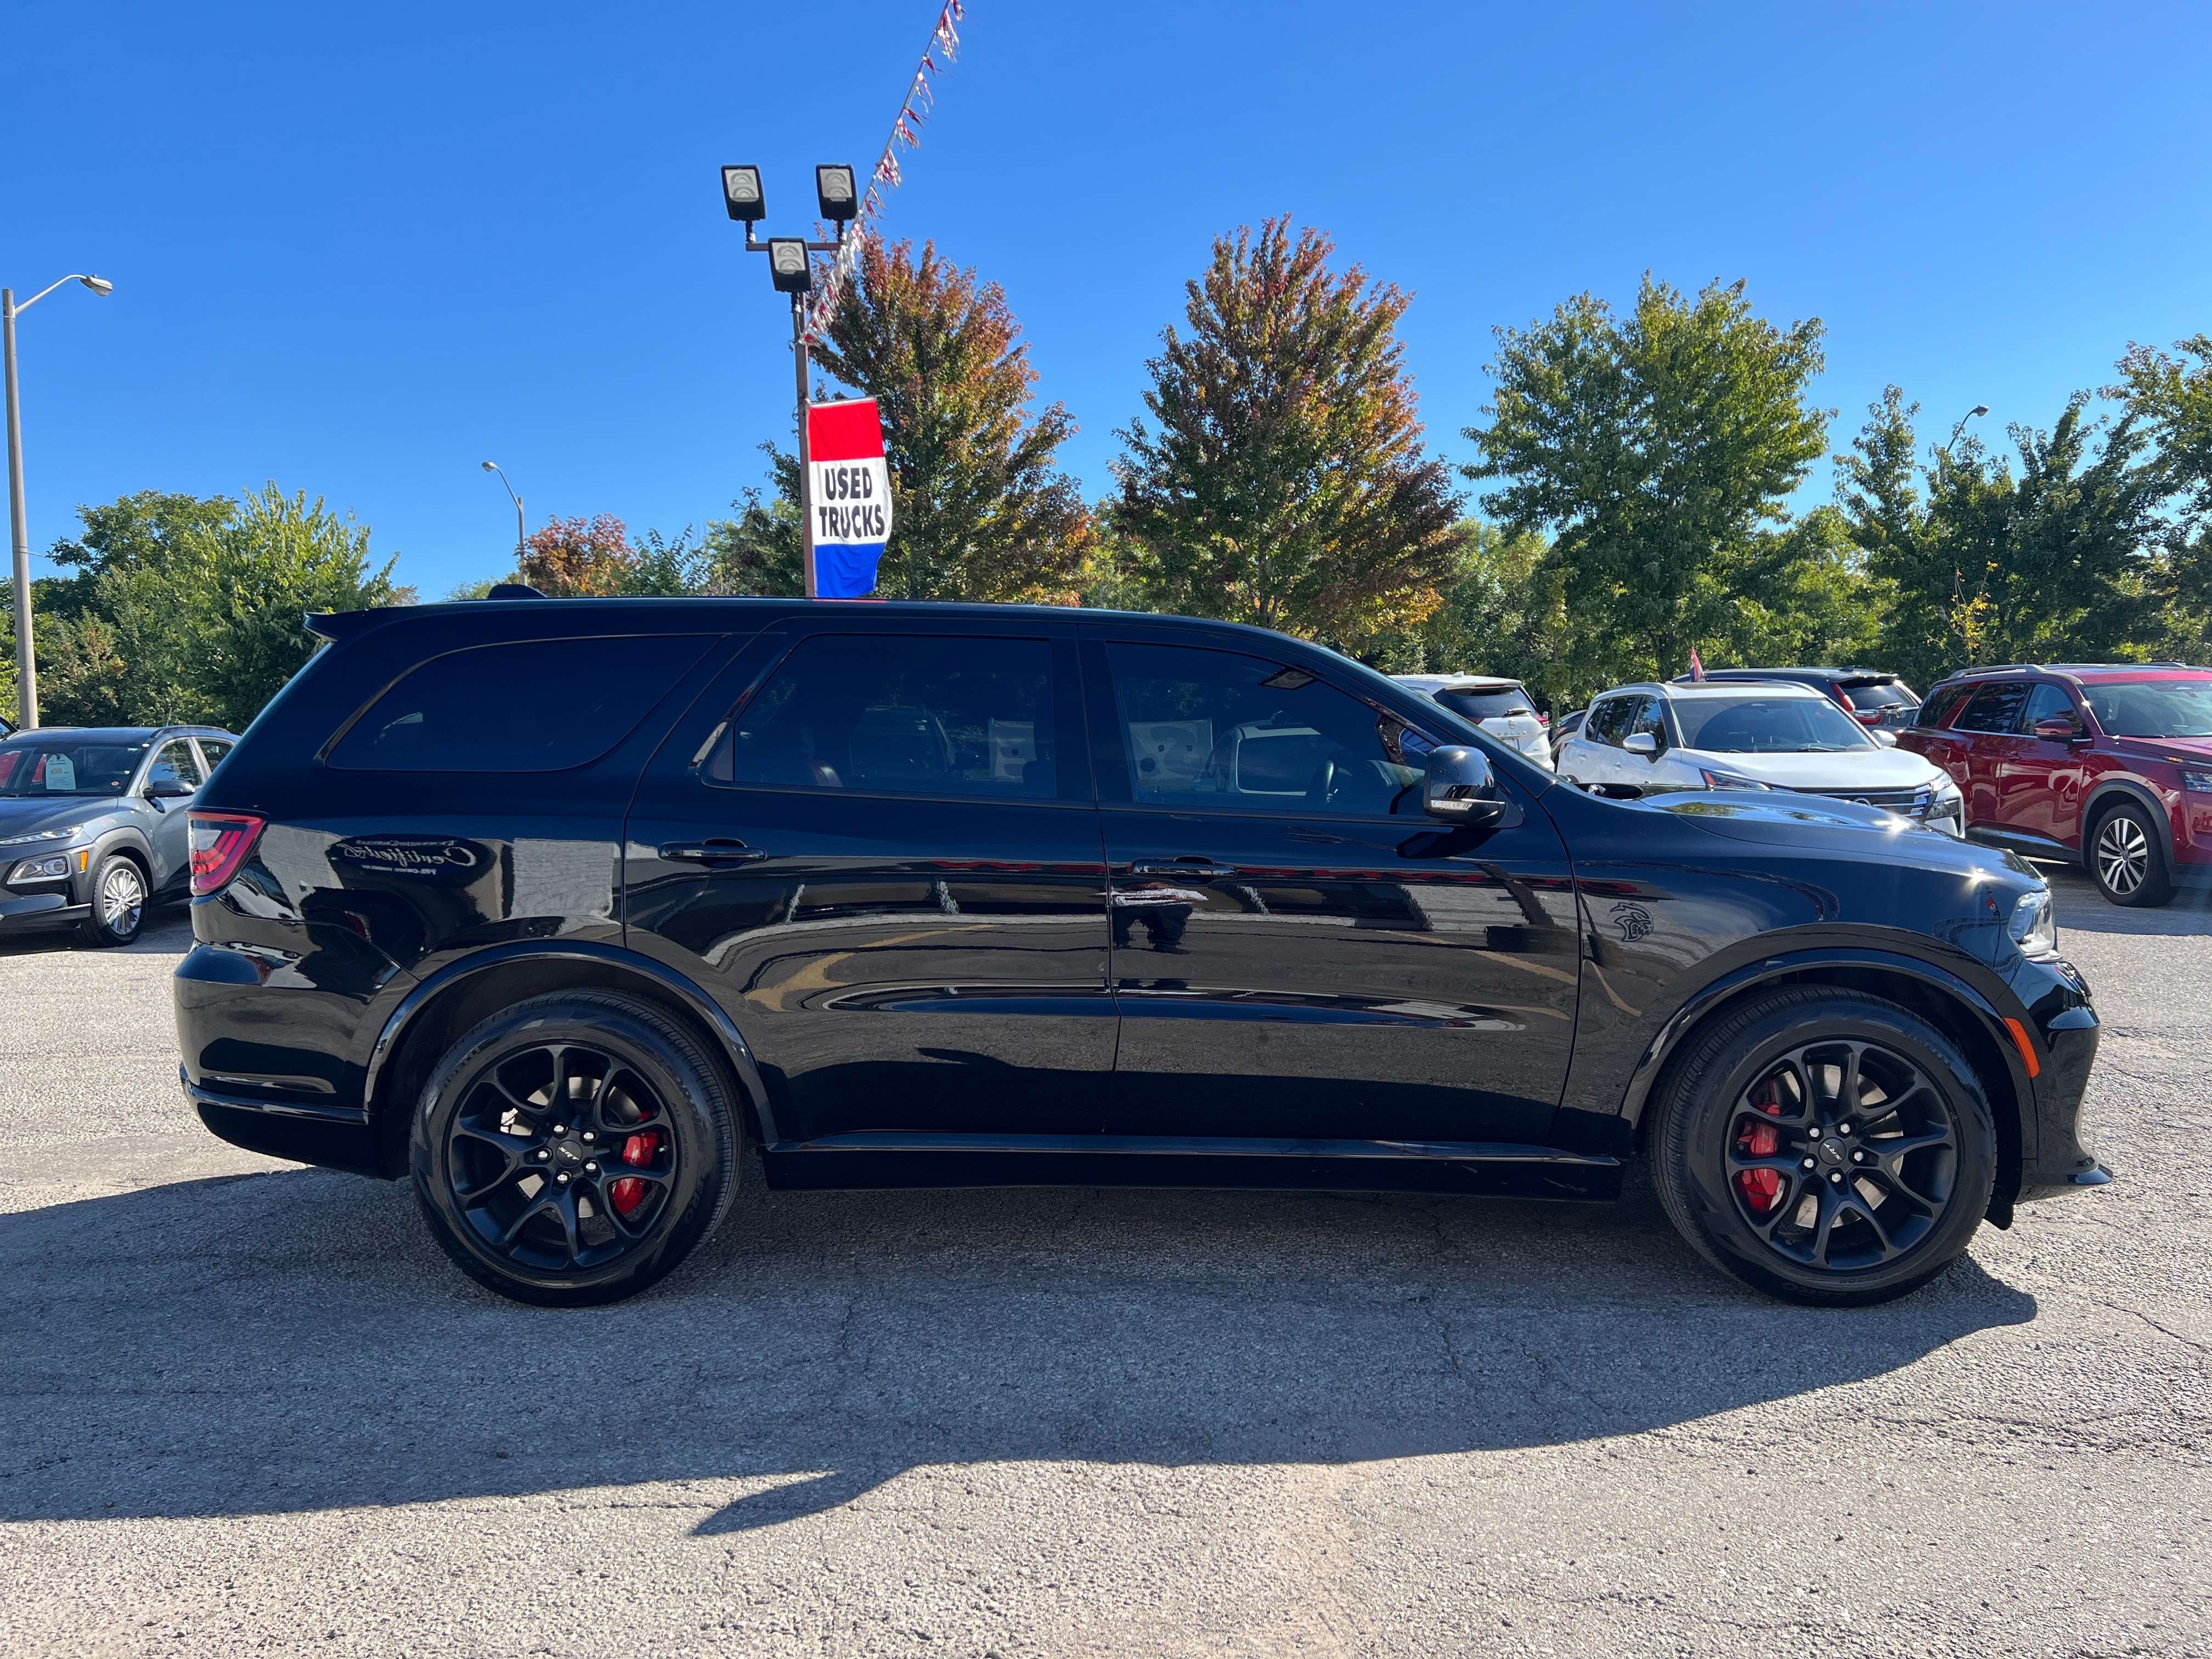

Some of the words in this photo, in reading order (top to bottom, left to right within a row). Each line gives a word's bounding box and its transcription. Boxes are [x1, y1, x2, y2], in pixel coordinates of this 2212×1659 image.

[825, 467, 873, 500] USED
[819, 504, 885, 538] TRUCKS
[558, 1147, 580, 1160] SRT
[1823, 1143, 1842, 1160] SRT
